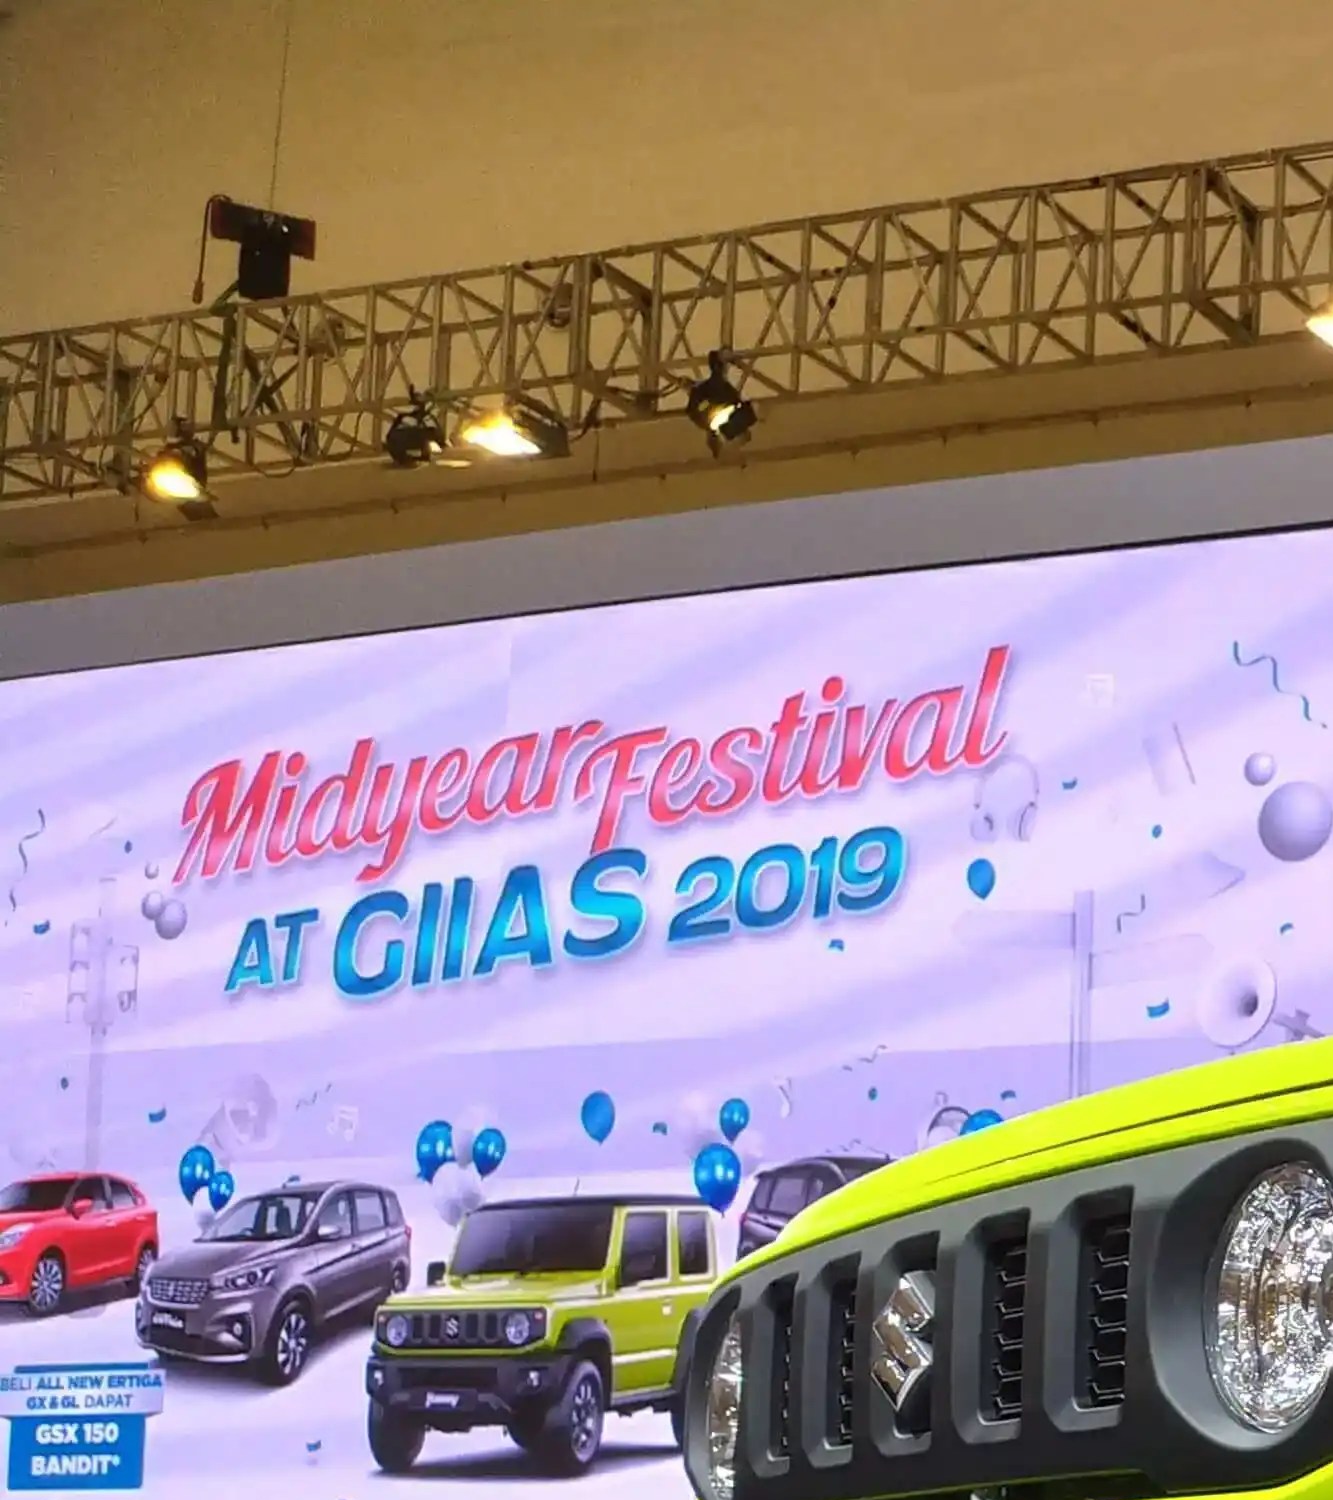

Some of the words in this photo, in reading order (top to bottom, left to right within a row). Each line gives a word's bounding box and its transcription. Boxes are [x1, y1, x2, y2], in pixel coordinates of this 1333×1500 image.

[171, 719, 604, 884] Midyear
[574, 644, 1009, 855] Festival
[224, 908, 320, 992] AT
[332, 847, 648, 998] GIIAS
[668, 826, 904, 943] 2019
[37, 1375, 64, 1390] ALL
[68, 1375, 104, 1389] NEW
[107, 1374, 162, 1388] ERTIGA
[84, 1394, 133, 1408] DAPAT
[36, 1423, 78, 1444] GSX
[83, 1422, 119, 1443] 150
